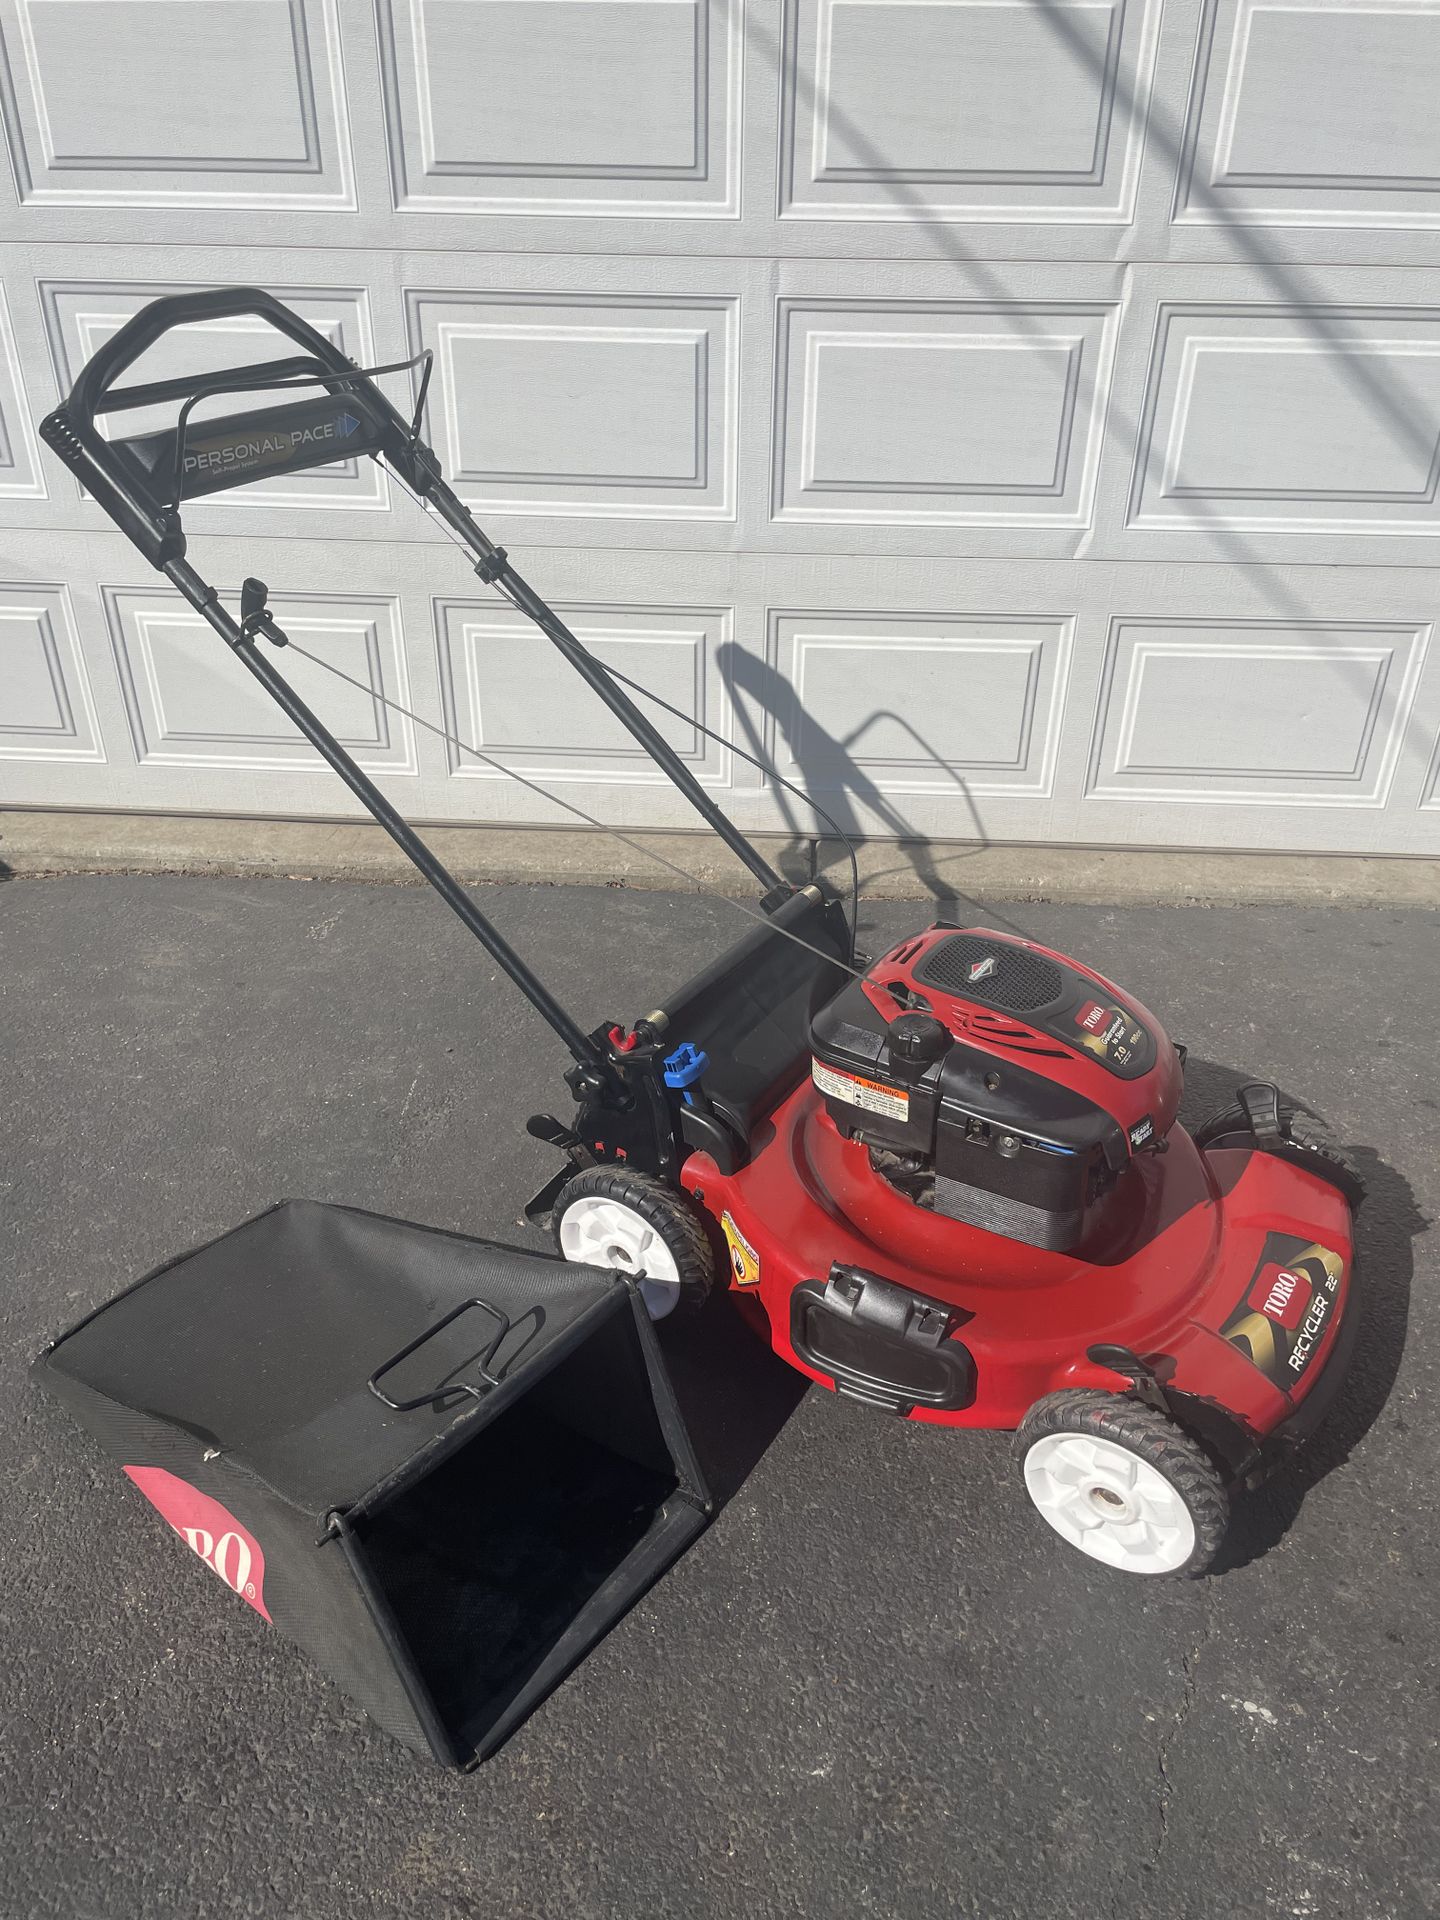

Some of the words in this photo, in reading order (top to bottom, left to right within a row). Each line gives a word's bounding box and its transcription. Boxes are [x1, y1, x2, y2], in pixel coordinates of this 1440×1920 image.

[184, 436, 285, 472] PERSONAL
[290, 423, 334, 446] PACE
[1082, 1006, 1104, 1029] TORO
[1101, 1016, 1123, 1045] Guaranteed
[1113, 1046, 1127, 1061] 7.0
[867, 1082, 900, 1098] WARNING
[1263, 1272, 1297, 1318] TORO
[1288, 1293, 1329, 1371] RECYCLER
